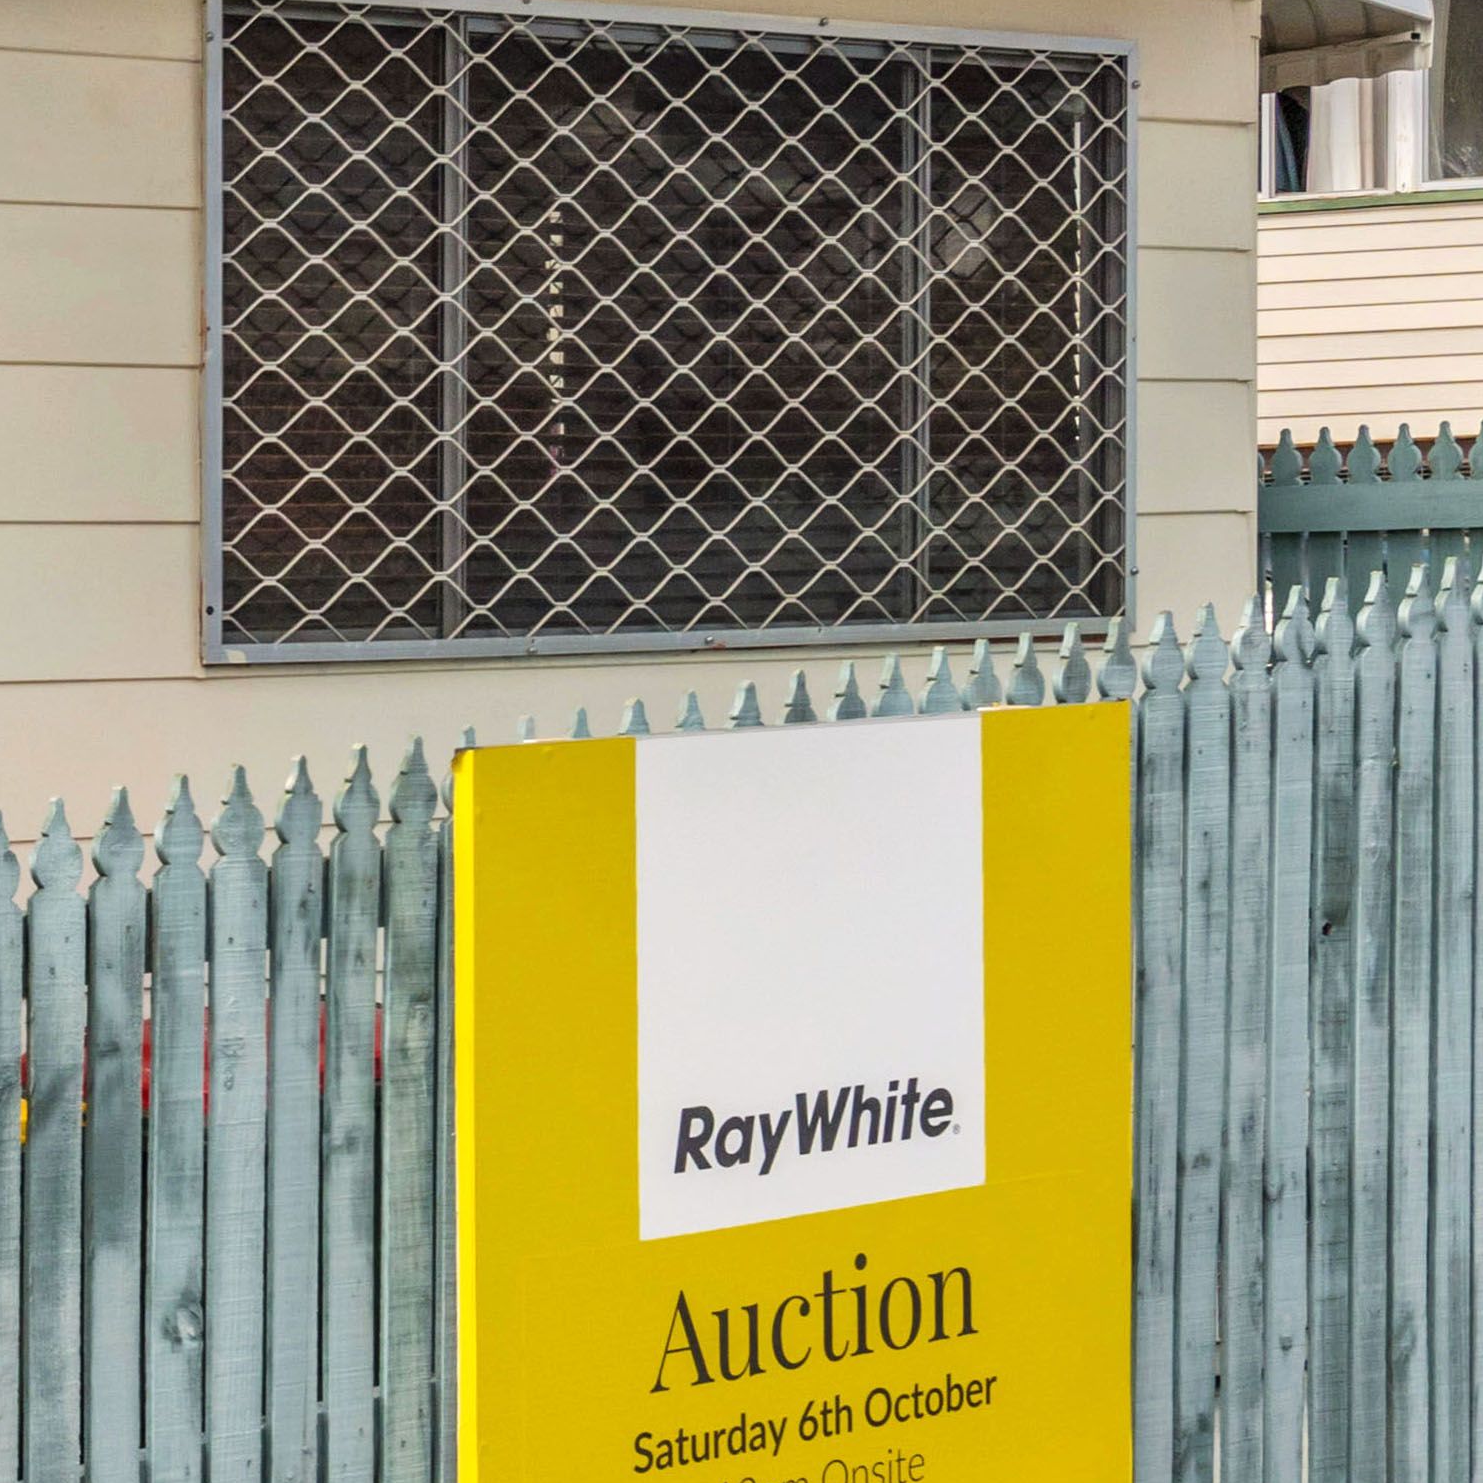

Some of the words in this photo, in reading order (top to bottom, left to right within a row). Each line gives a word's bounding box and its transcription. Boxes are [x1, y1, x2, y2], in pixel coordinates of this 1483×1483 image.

[649, 1252, 979, 1395] Auction
[633, 1412, 788, 1474] Saturday
[798, 1394, 854, 1442] 6th
[864, 1372, 998, 1428] October
